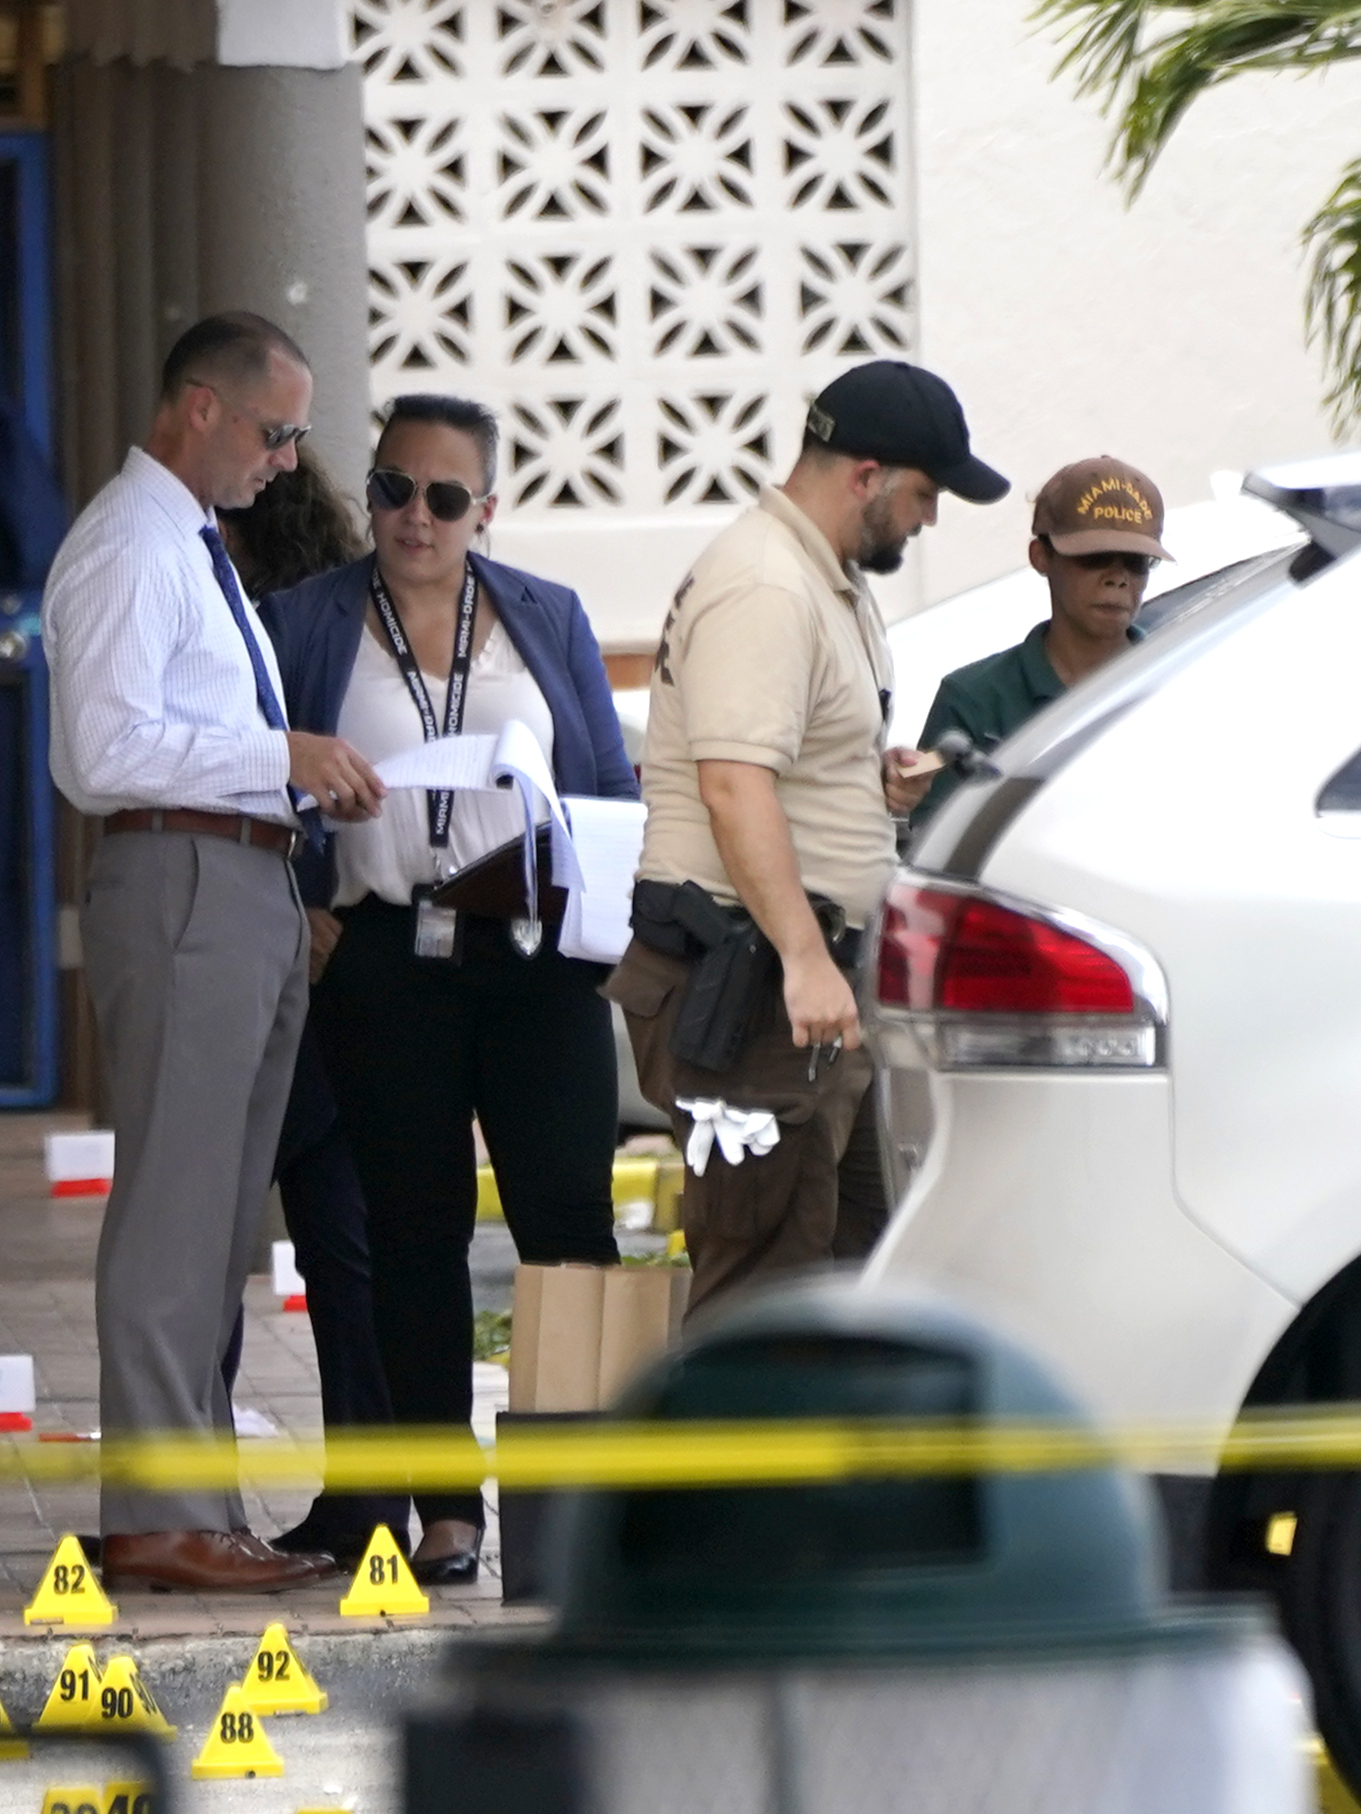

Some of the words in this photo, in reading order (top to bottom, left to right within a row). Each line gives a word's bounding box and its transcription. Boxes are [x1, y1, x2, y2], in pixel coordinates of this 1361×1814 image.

[1076, 477, 1153, 521] MIAMI-DADE
[1093, 506, 1143, 525] POLICE
[376, 592, 408, 656] HOMICIDE
[447, 673, 465, 737] HOMICIDE
[457, 575, 476, 658] MIAMI-DADE
[53, 1564, 86, 1596] 82
[369, 1554, 399, 1587] 81
[257, 1650, 291, 1682] 92
[59, 1668, 90, 1702] 91
[100, 1686, 134, 1720] 90
[220, 1711, 255, 1745] 88
